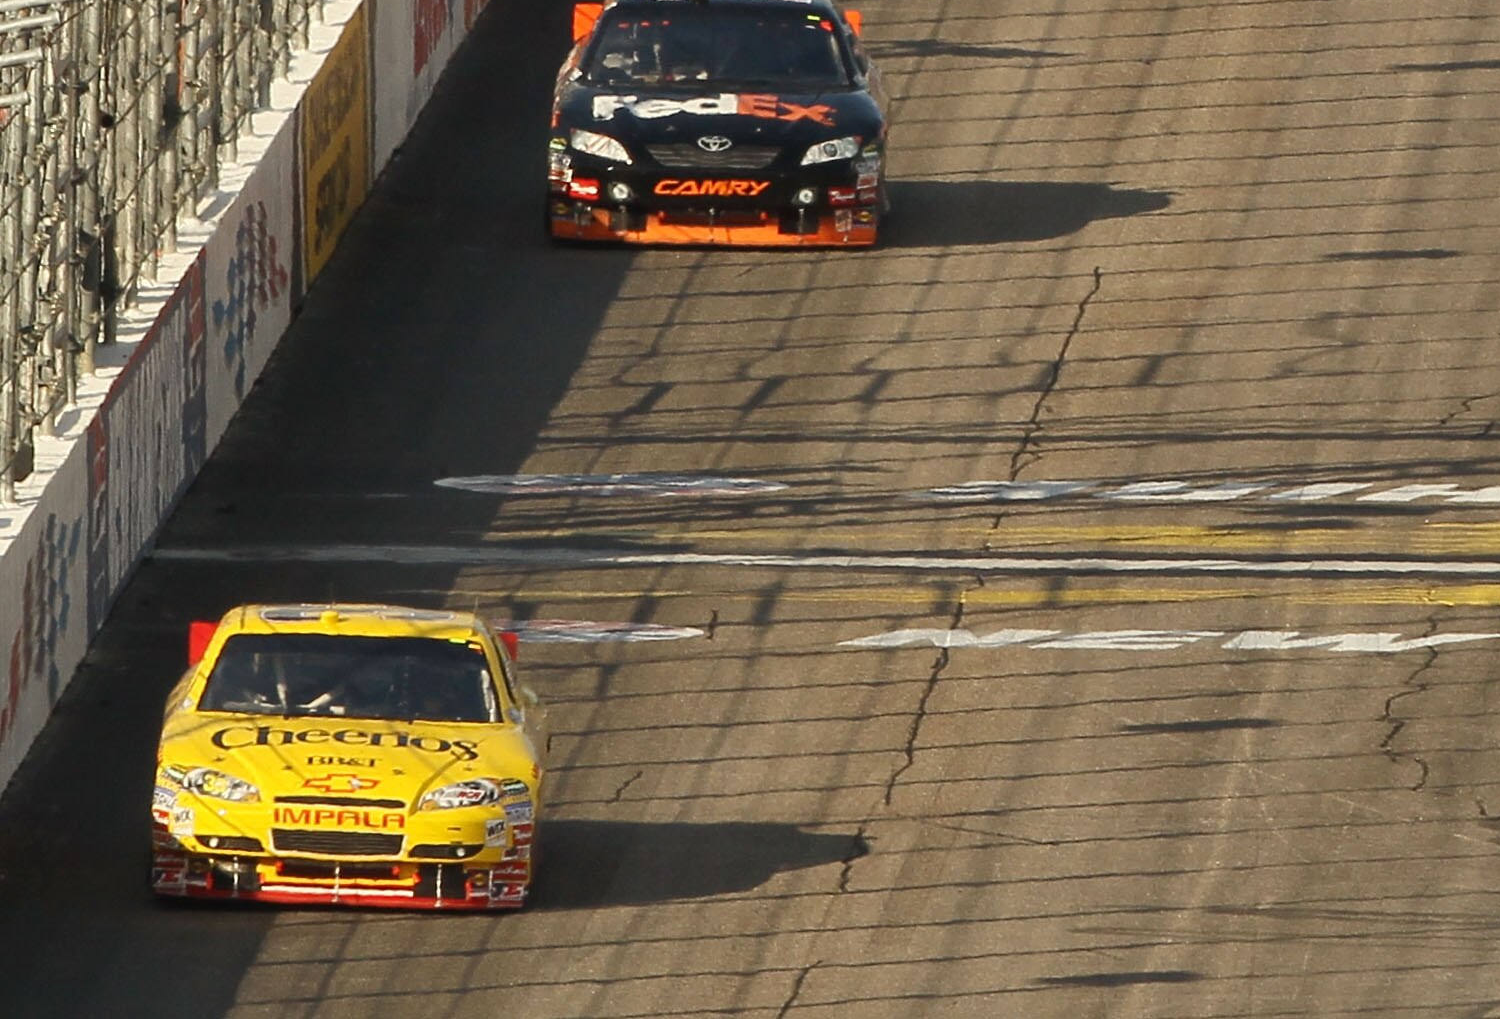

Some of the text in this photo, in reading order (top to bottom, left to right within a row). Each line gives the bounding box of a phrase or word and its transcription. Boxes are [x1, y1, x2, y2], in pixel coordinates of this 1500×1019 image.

[592, 92, 838, 127] FedEx
[653, 179, 771, 196] CAMRY
[210, 726, 479, 761] Cheerios
[273, 807, 405, 829] IMPALA
